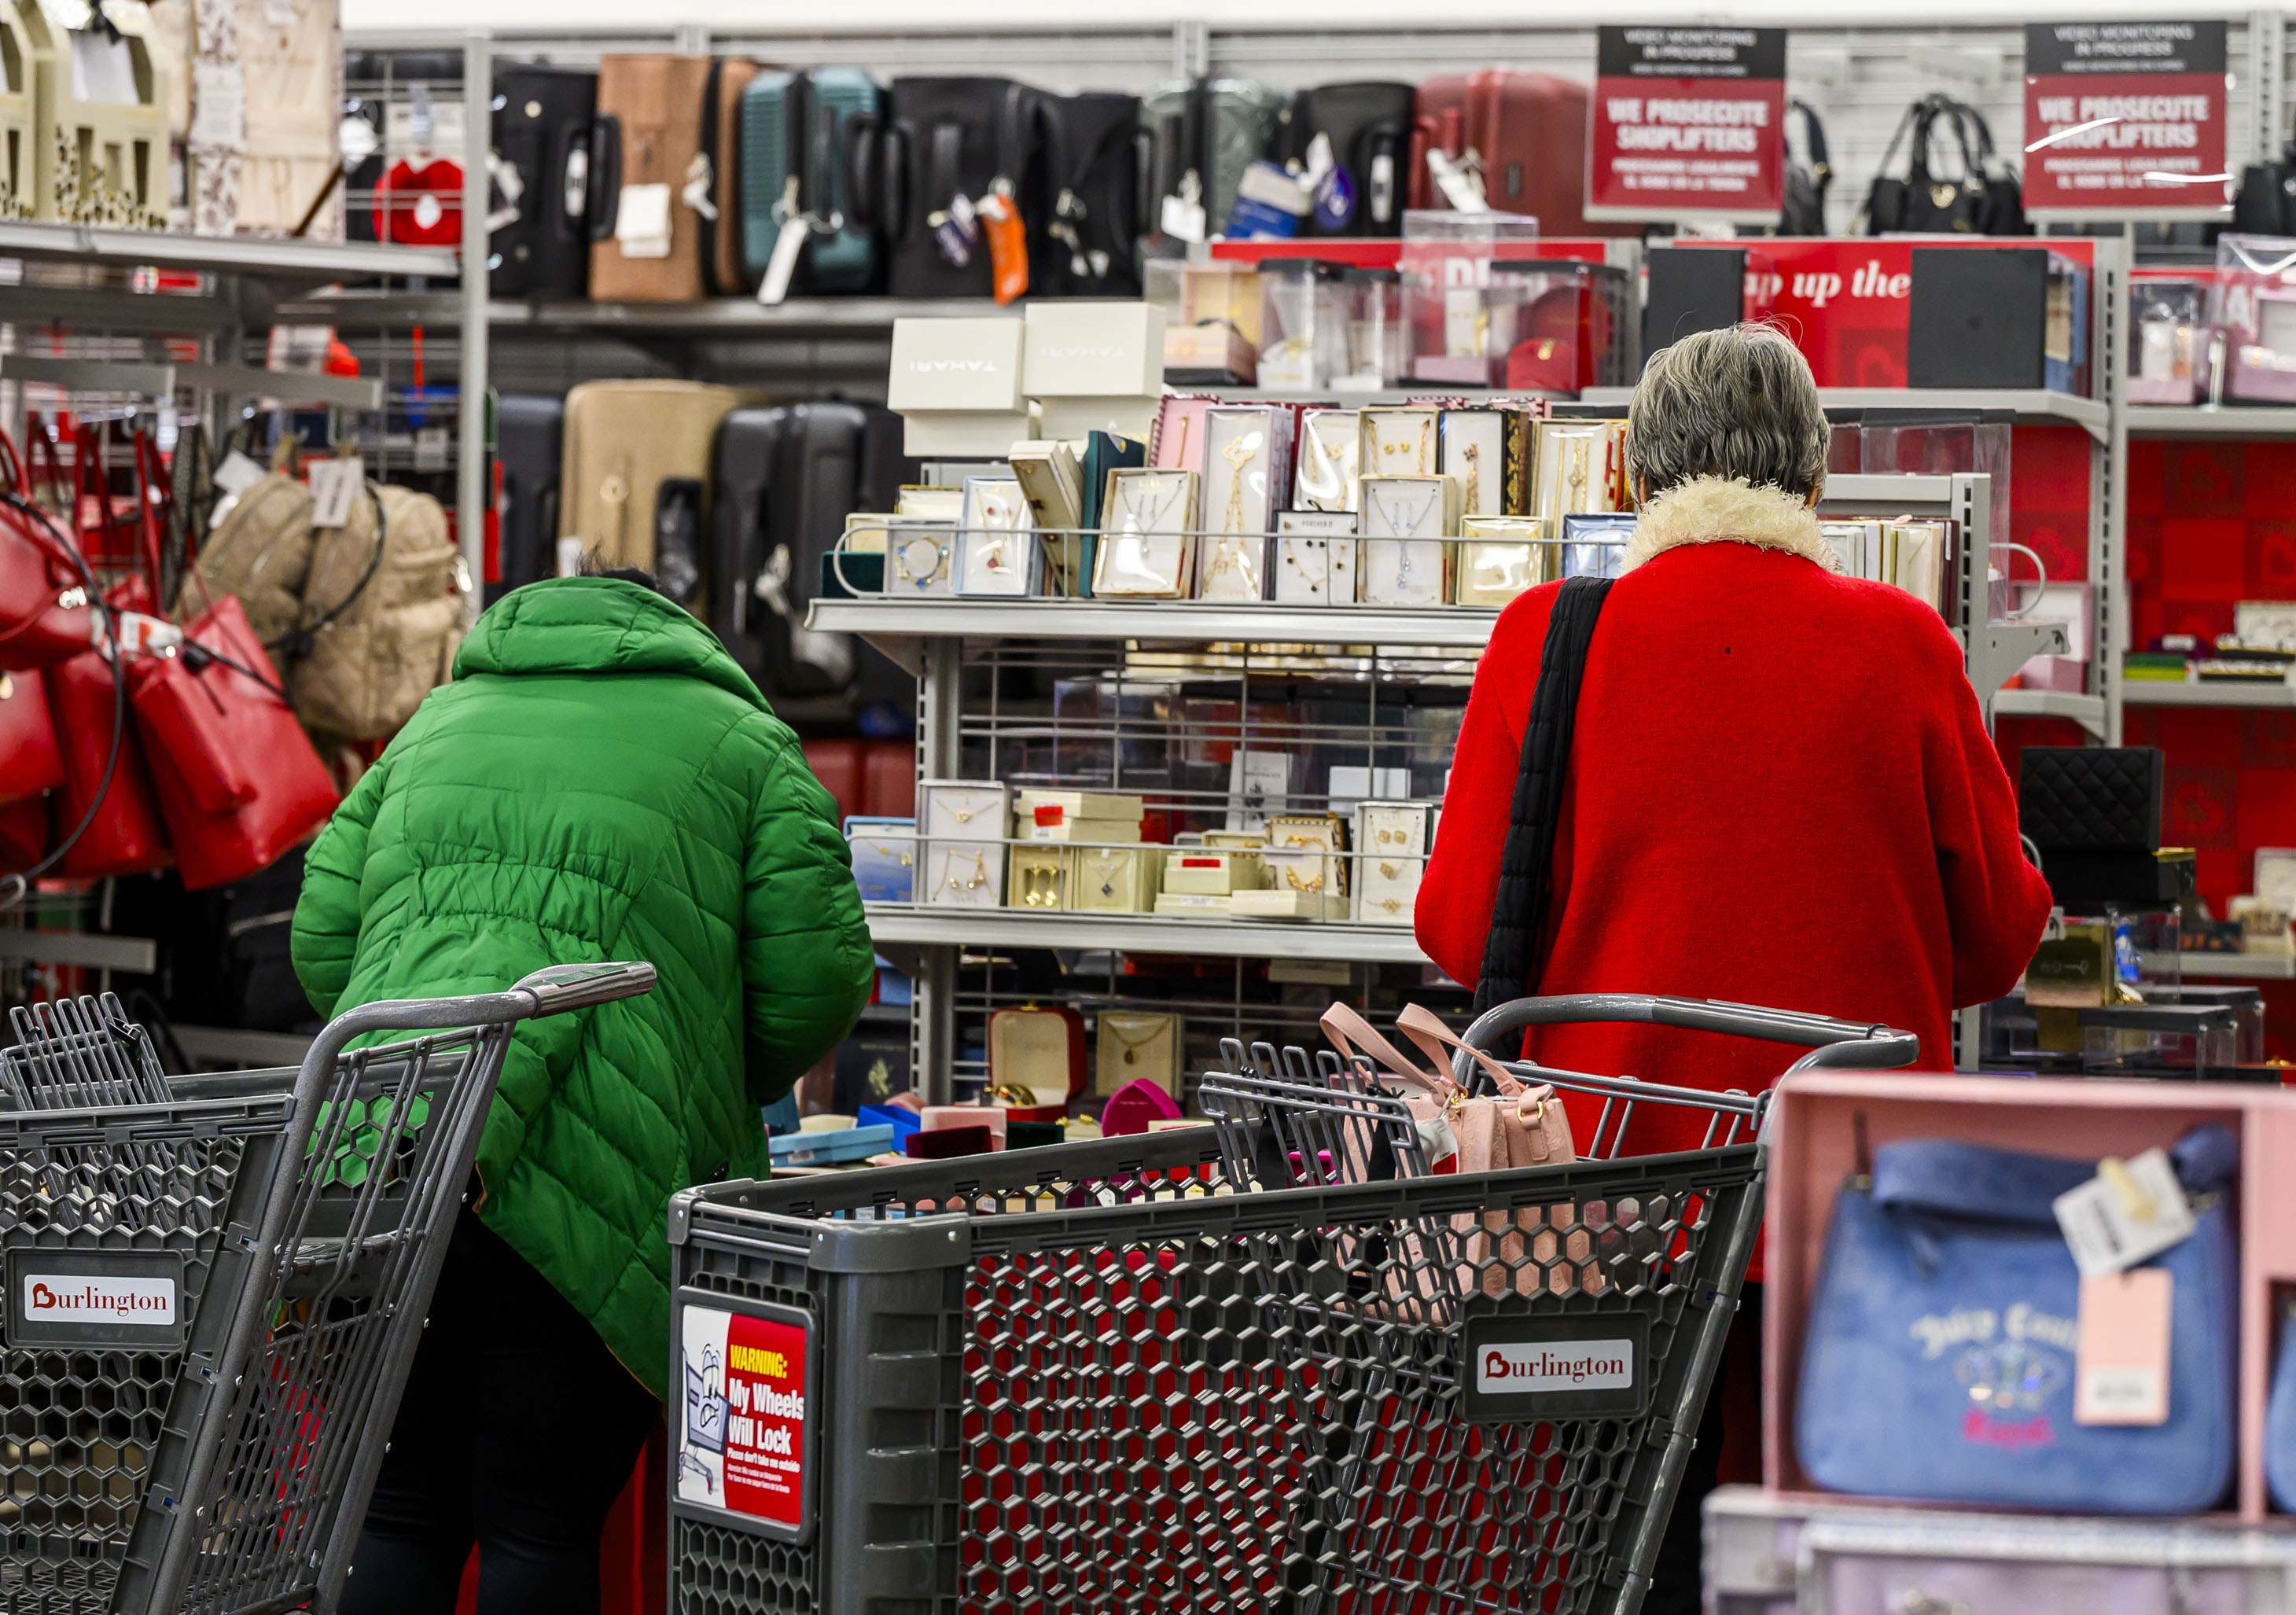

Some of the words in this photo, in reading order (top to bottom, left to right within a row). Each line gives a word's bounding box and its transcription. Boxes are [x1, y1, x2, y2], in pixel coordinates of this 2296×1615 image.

[1607, 97, 1643, 123] WE
[1646, 97, 1769, 127] PROSECUTE
[2037, 95, 2076, 123] WE
[2079, 94, 2210, 122] PROSECUTE
[1617, 124, 1758, 153] SHOPLIFTERS
[1792, 273, 1842, 307] up
[1851, 259, 1911, 298] the
[909, 359, 998, 373] TAHARI
[32, 1282, 168, 1317] Burlington
[730, 1344, 789, 1379] WARNING:
[1485, 1351, 1624, 1383] Burlington
[729, 1378, 750, 1415] My
[752, 1381, 804, 1421] Wheels
[728, 1415, 754, 1448] Will
[756, 1420, 793, 1455] Lock
